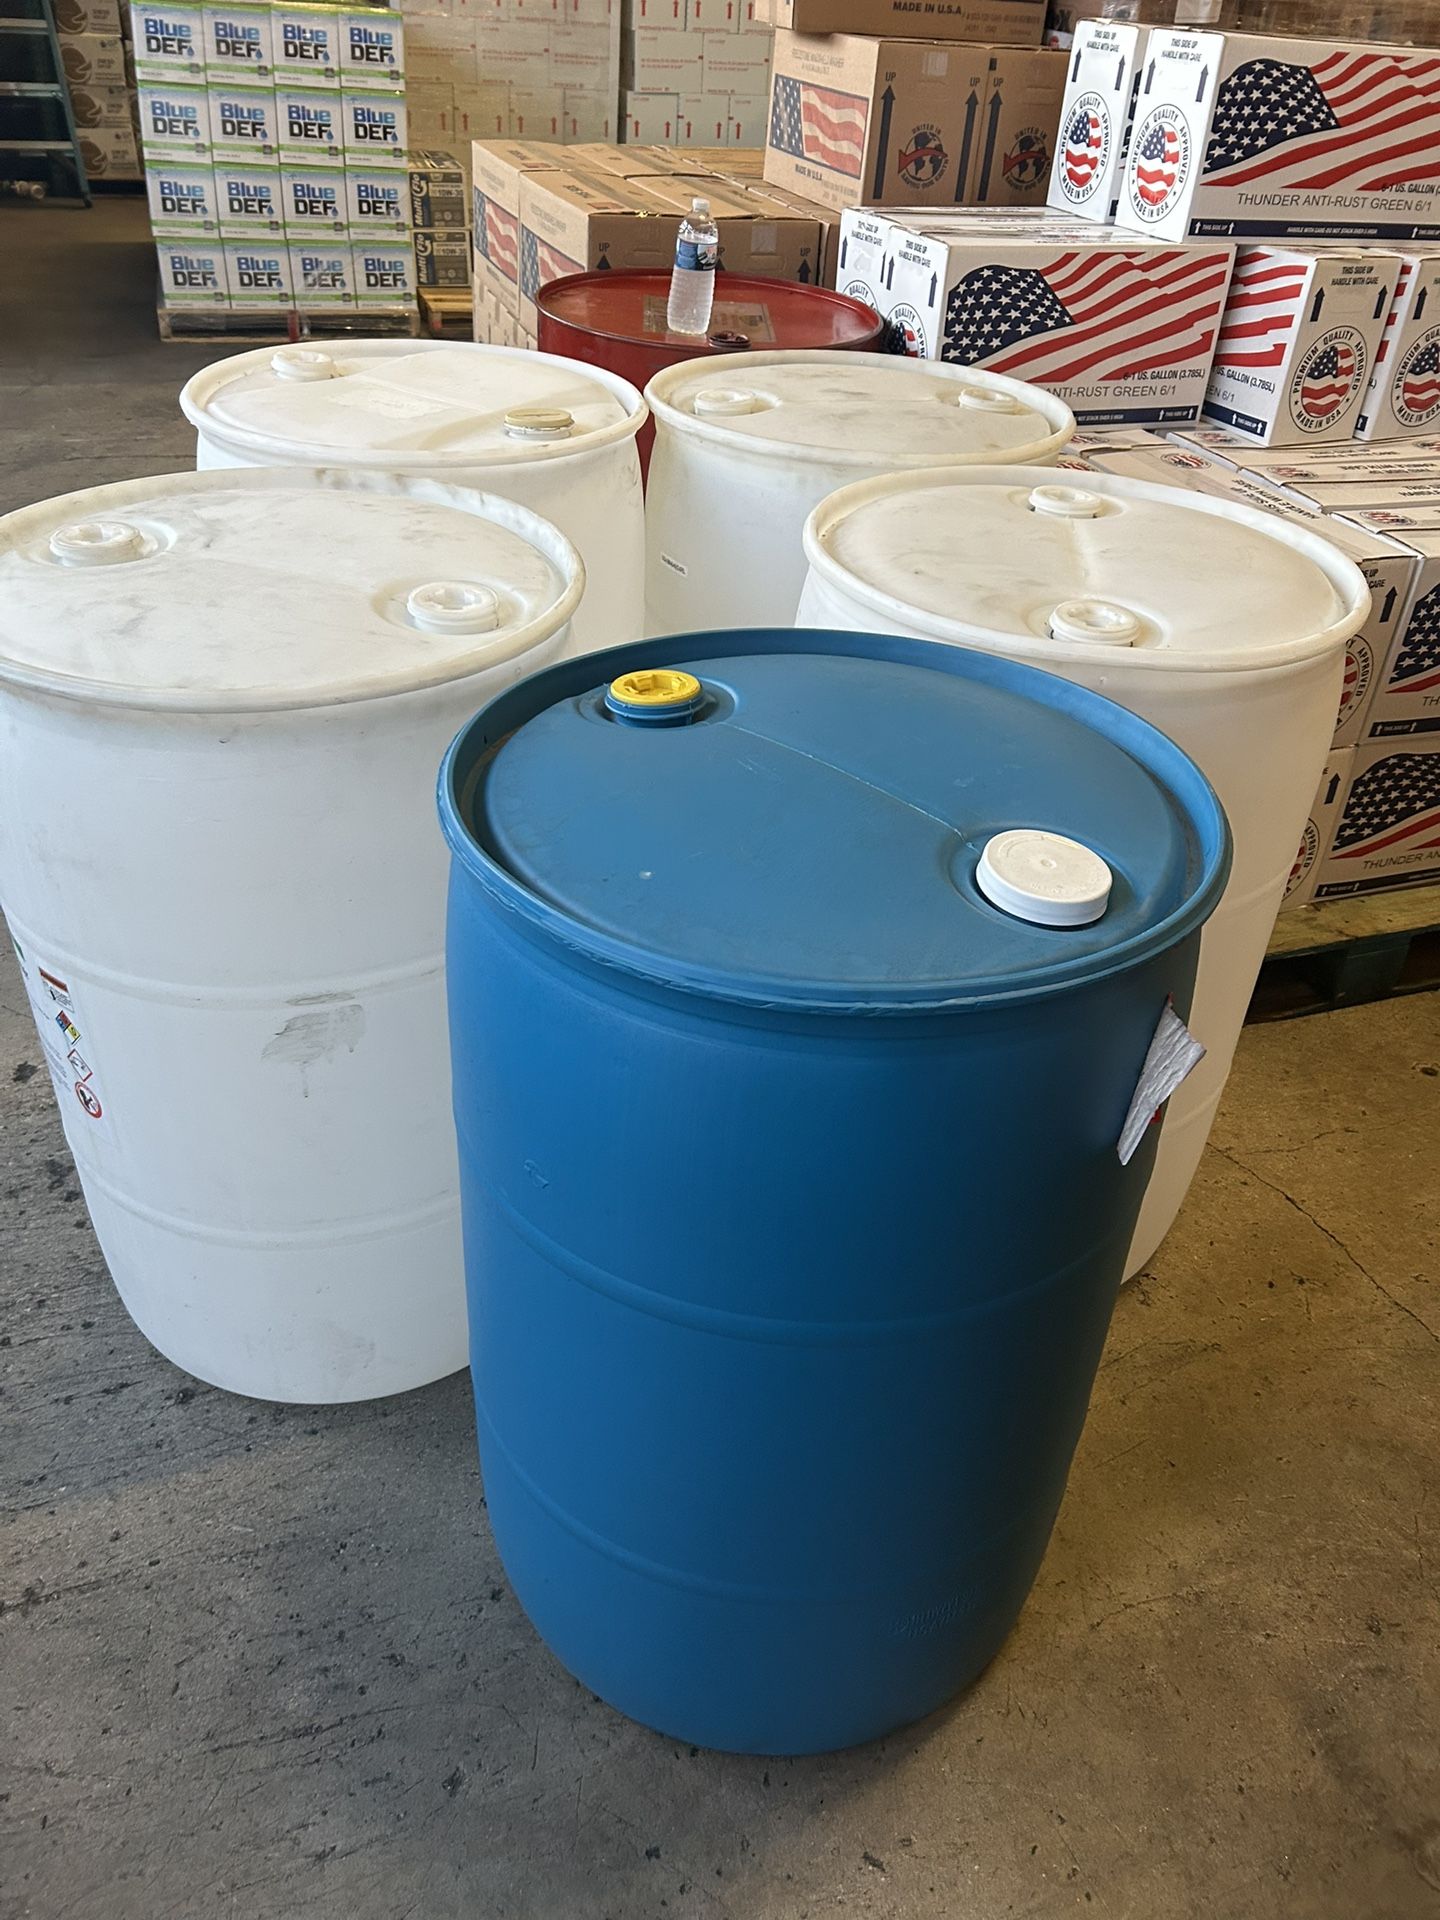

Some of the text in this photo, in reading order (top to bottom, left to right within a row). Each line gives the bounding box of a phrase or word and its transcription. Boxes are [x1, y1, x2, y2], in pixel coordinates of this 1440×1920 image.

[893, 2, 921, 12] MADE
[925, 4, 935, 12] IN
[145, 18, 192, 37] Blue
[214, 22, 260, 40] Blue
[283, 24, 327, 42] Blue
[350, 27, 392, 45] Blue
[146, 37, 192, 54] DEF
[216, 38, 260, 57] DEF
[284, 41, 327, 59] DEF
[1171, 38, 1198, 48] THIS SIDE UP
[351, 44, 392, 62] DEF
[1161, 51, 1178, 60] HANDLE
[1178, 52, 1188, 60] WITH
[886, 72, 896, 81] UP
[970, 78, 980, 86] UP
[994, 78, 1003, 86] UP
[152, 100, 197, 118] Blue
[220, 103, 265, 121] Blue
[288, 104, 331, 122] Blue
[354, 107, 395, 125] Blue
[153, 118, 198, 136] DEF
[222, 119, 265, 138] DEF
[289, 121, 331, 140] DEF
[354, 123, 396, 141] DEF
[1060, 96, 1110, 168] PREMIUM QUALITY APPROVED
[1131, 108, 1189, 184] PREMIUM QUALITY APPROVED
[160, 181, 204, 197] Blue
[227, 181, 271, 198] Blue
[293, 183, 335, 199] Blue
[357, 184, 398, 200] Blue
[1062, 174, 1074, 199] MADE
[1074, 190, 1081, 199] IN
[1082, 184, 1093, 198] USA
[1408, 184, 1435, 194] GALLON
[161, 198, 204, 214] DEF
[229, 198, 271, 215] DEF
[294, 200, 335, 216] DEF
[358, 200, 398, 216] DEF
[1132, 193, 1146, 216] MADE
[1156, 201, 1169, 217] USA
[1238, 192, 1432, 212] THUNDER ANTI-RUST GREEN 6/1
[599, 243, 610, 252] UP
[800, 248, 811, 256] UP
[906, 240, 928, 254] THIS SIDE UP
[170, 255, 214, 272] Blue
[237, 256, 279, 272] Blue
[302, 257, 343, 272] Blue
[364, 258, 405, 273] Blue
[899, 250, 931, 268] HANDLE WITH CARE
[1342, 266, 1374, 274] THIS SIDE UP
[173, 271, 215, 288] DEF
[239, 272, 280, 288] DEF
[304, 272, 343, 288] DEF
[366, 273, 405, 288] DEF
[1331, 277, 1379, 286] HANDLE WITH CARE
[849, 285, 868, 298] QUALITY
[895, 307, 926, 360] QUALITY APPRO
[1293, 330, 1364, 394] PREMIUM QUALITY APPROVED
[1395, 343, 1421, 390] PREMIUM
[1151, 370, 1177, 379] GALLON
[1179, 368, 1205, 380] (3.785L)
[1227, 369, 1250, 384] GALLON
[1112, 385, 1156, 397] GREEN
[1160, 384, 1176, 396] 6/1
[1222, 390, 1235, 402] 6/1
[1296, 409, 1342, 429] MADE IN USA
[1397, 405, 1414, 422] MADE
[1369, 569, 1378, 577] UP
[1369, 579, 1386, 589] CARE
[1356, 647, 1369, 696] APPROVED
[1304, 826, 1317, 868] APPROVED
[1363, 853, 1424, 870] THUNDER
